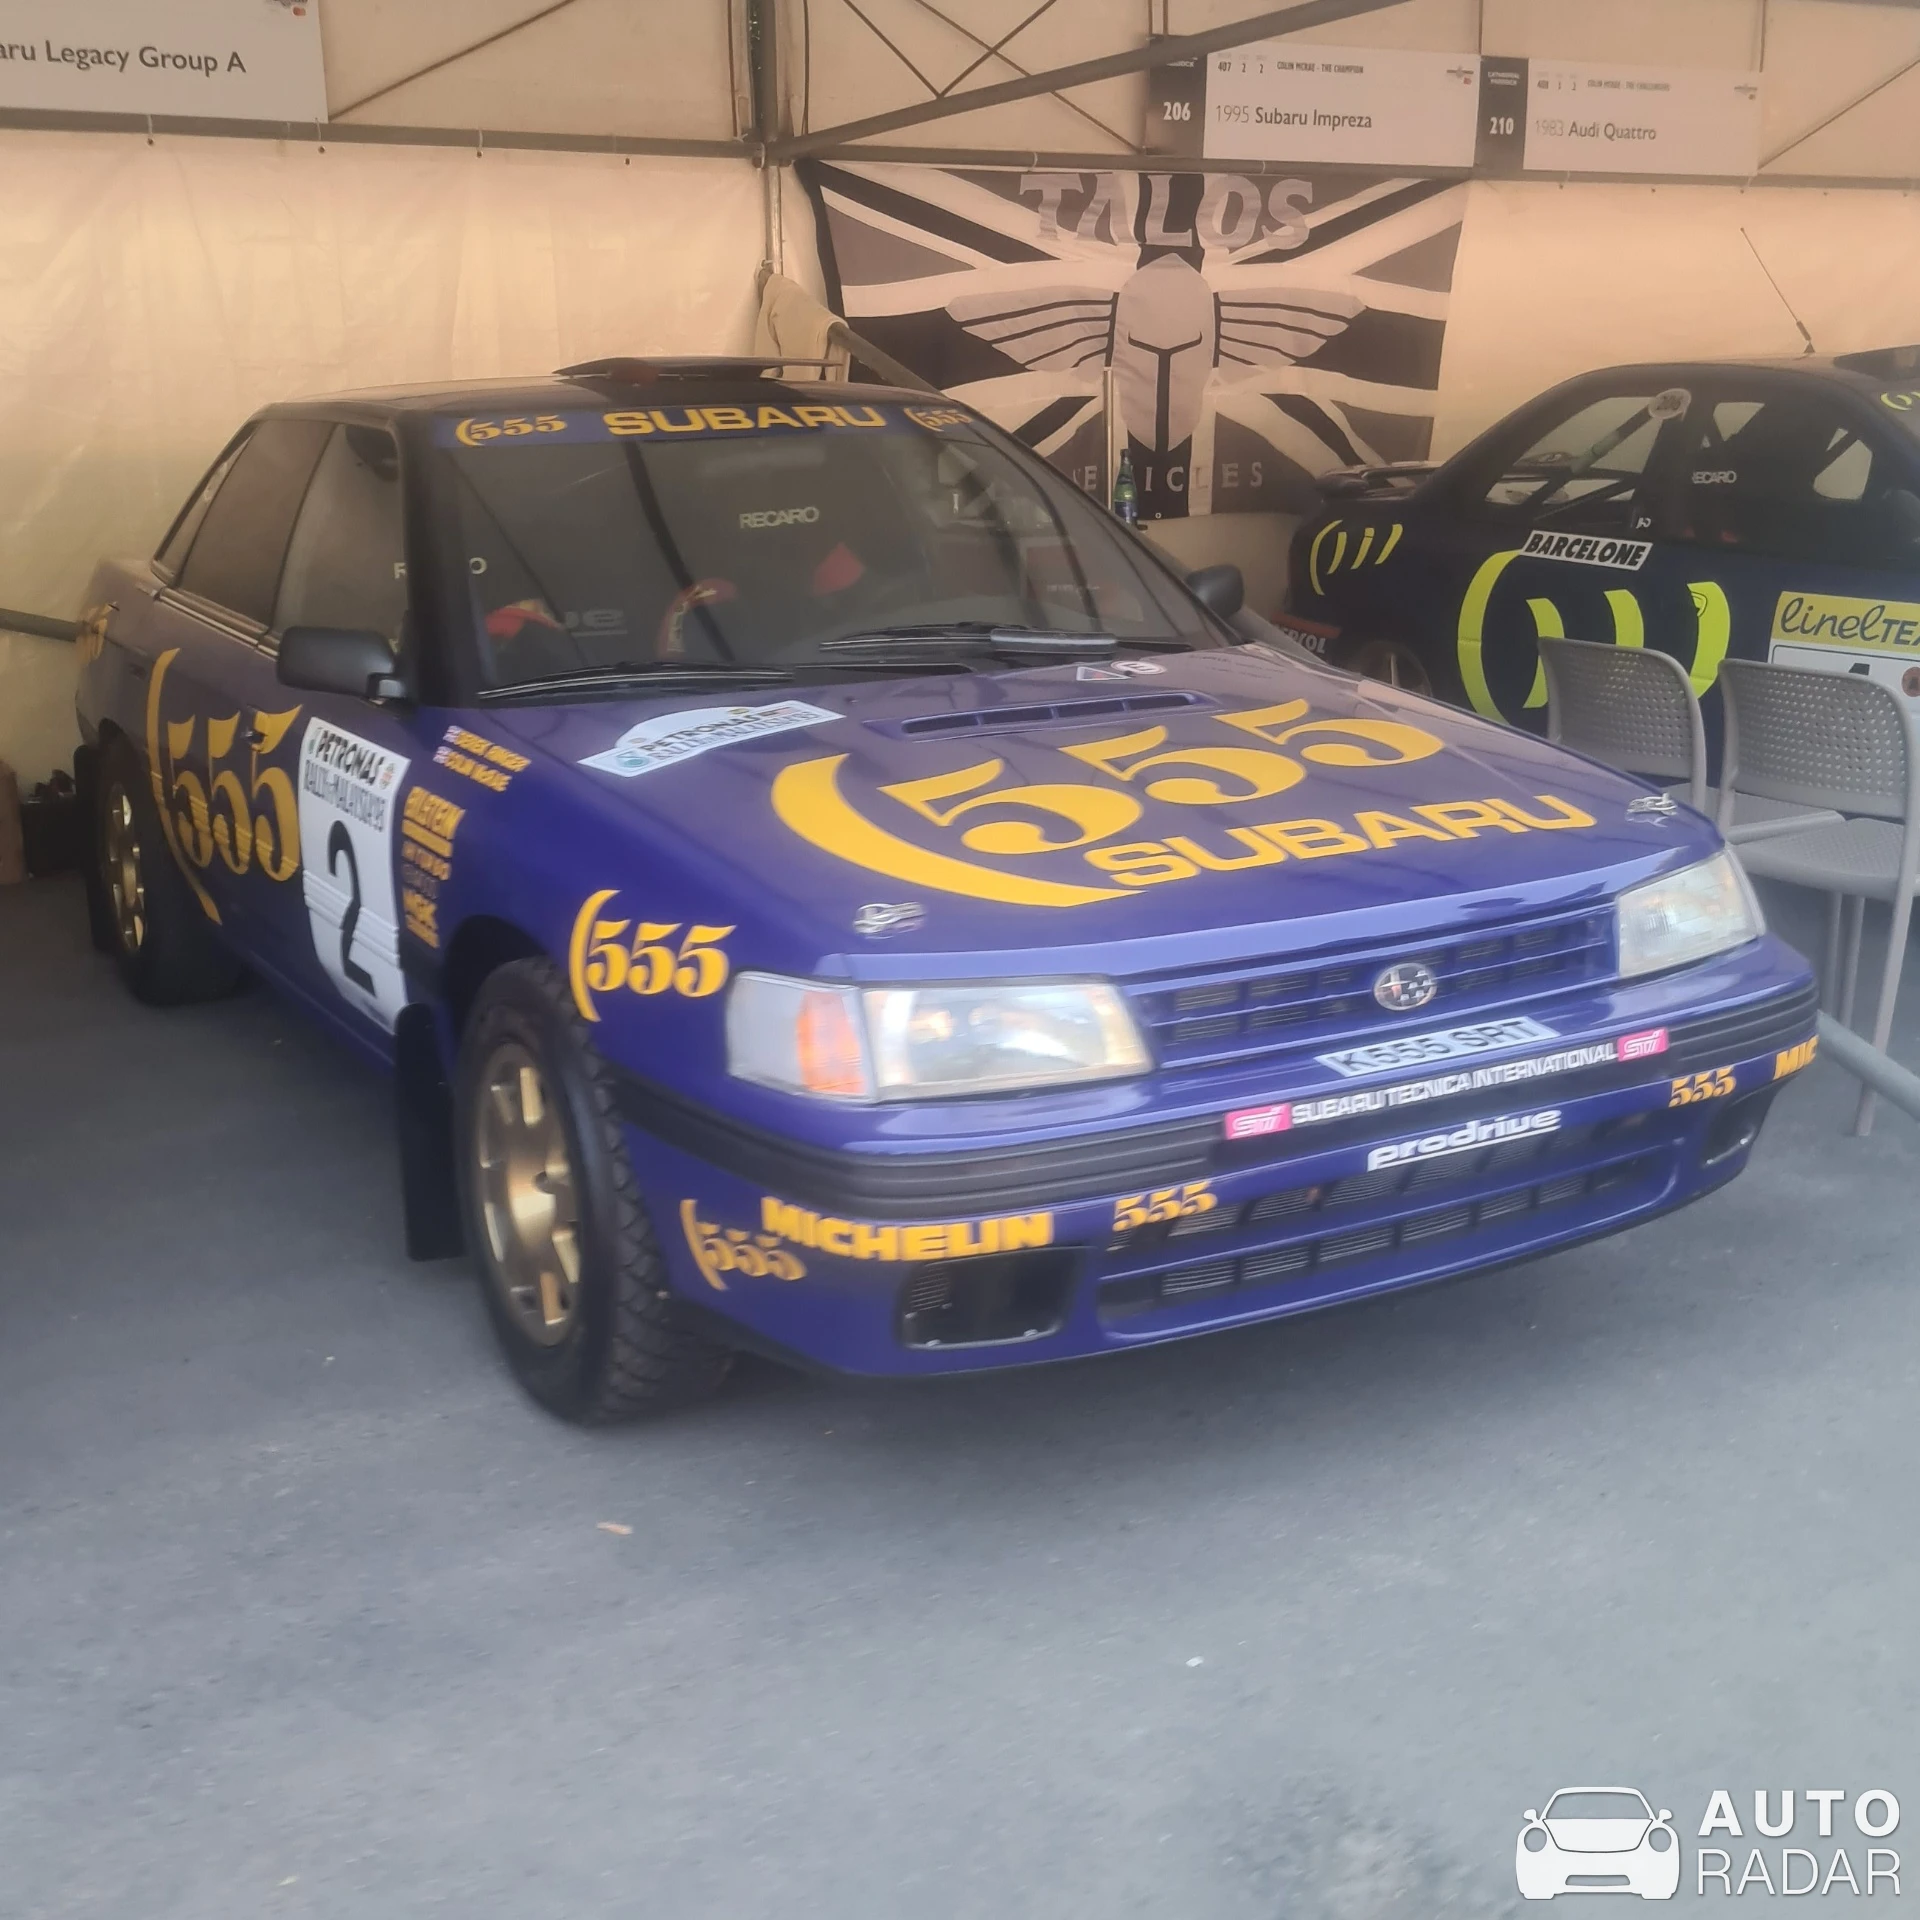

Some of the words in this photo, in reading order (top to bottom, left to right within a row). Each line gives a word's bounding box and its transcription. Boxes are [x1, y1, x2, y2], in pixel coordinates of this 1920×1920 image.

[0, 43, 37, 61] aru
[45, 40, 130, 73] Legacy
[139, 46, 218, 77] Group
[227, 51, 247, 73] A
[1277, 61, 1295, 70] COLIN
[1321, 63, 1332, 73] THE
[1163, 102, 1192, 121] 206
[1216, 104, 1250, 124] 1995
[1255, 106, 1308, 126] Subaru
[1313, 108, 1372, 131] Impreza
[1489, 116, 1514, 135] 210
[1568, 121, 1600, 138] Audi
[1604, 122, 1657, 141] Quattro
[1019, 173, 1313, 250] TALOS
[602, 406, 888, 436] SUBARU
[739, 506, 820, 529] RECARO
[1525, 533, 1647, 567] BARCELONE
[315, 729, 386, 786] PETRONAS
[1083, 793, 1599, 888] SUBARU
[328, 820, 377, 999] 2
[1327, 1037, 1450, 1072] K555
[1450, 1020, 1541, 1047] SRT
[1291, 1091, 1386, 1125] SUBARU
[1384, 1075, 1472, 1107] TECNICA
[1472, 1043, 1618, 1088] INTERNATIONAL
[1669, 1065, 1737, 1108] 555
[1367, 1110, 1562, 1172] prodrive
[1113, 1180, 1218, 1232] 555
[761, 1196, 1054, 1261] MICHELIN
